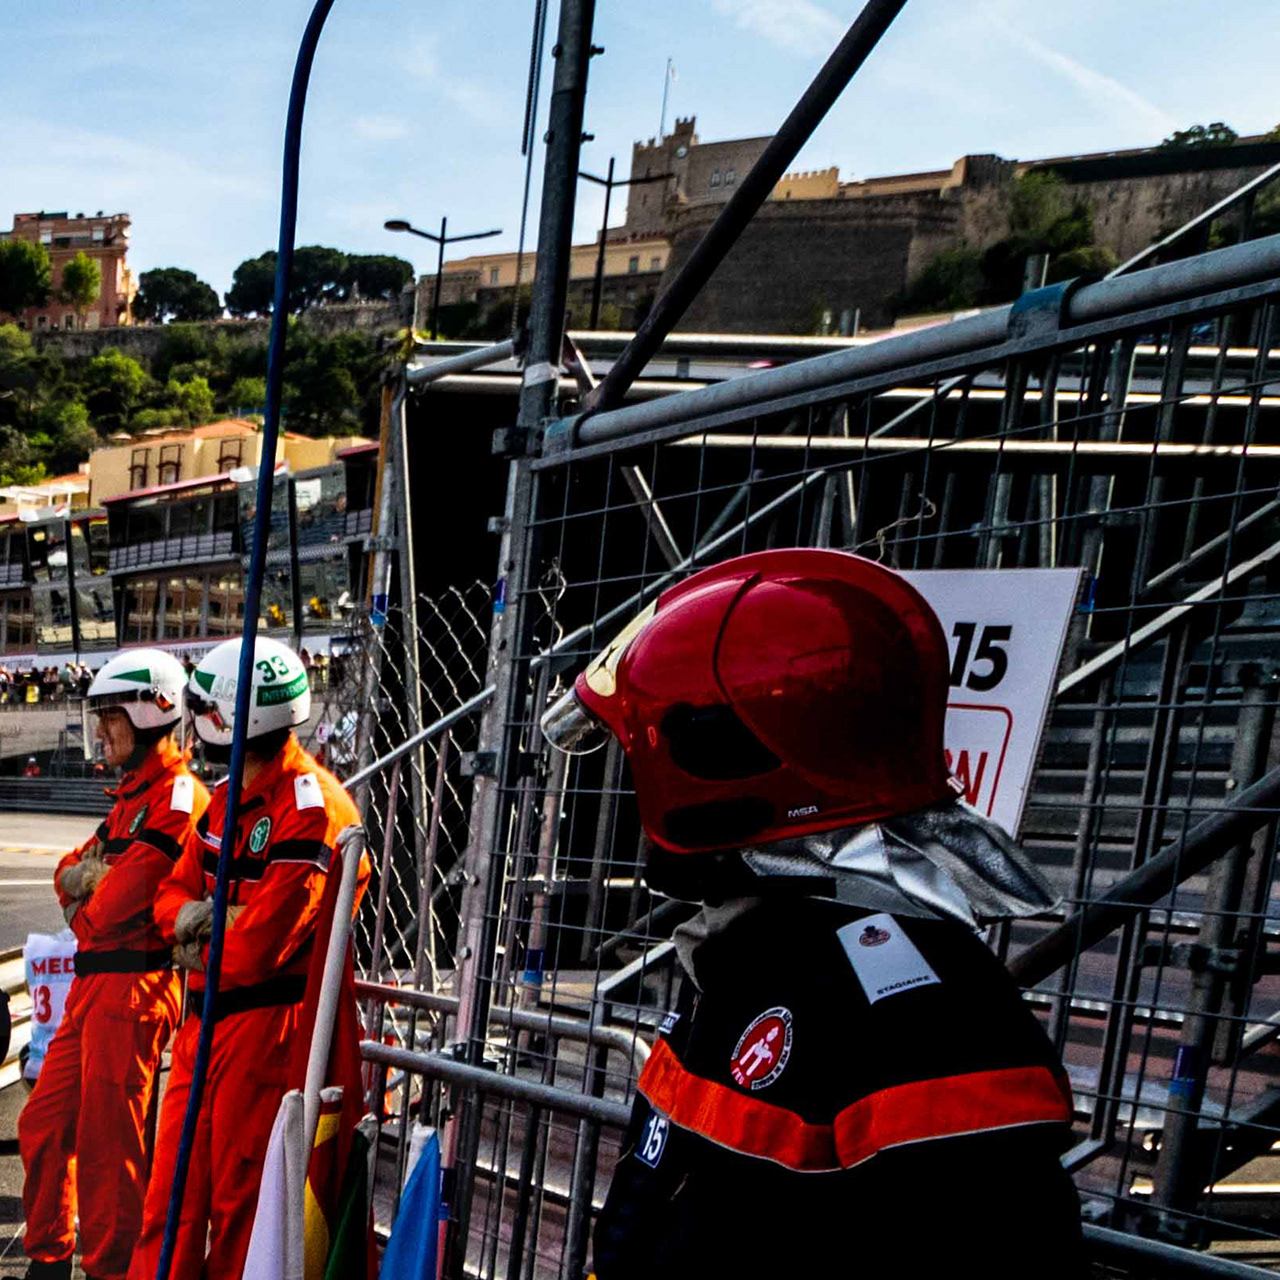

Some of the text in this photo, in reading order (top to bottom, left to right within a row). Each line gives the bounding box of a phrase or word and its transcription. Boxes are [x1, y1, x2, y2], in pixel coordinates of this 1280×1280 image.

[255, 654, 290, 683] 33
[950, 621, 1013, 692] 15
[787, 804, 819, 819] MSA
[876, 974, 931, 996] STAGIAIRE
[642, 1117, 666, 1160] 15
